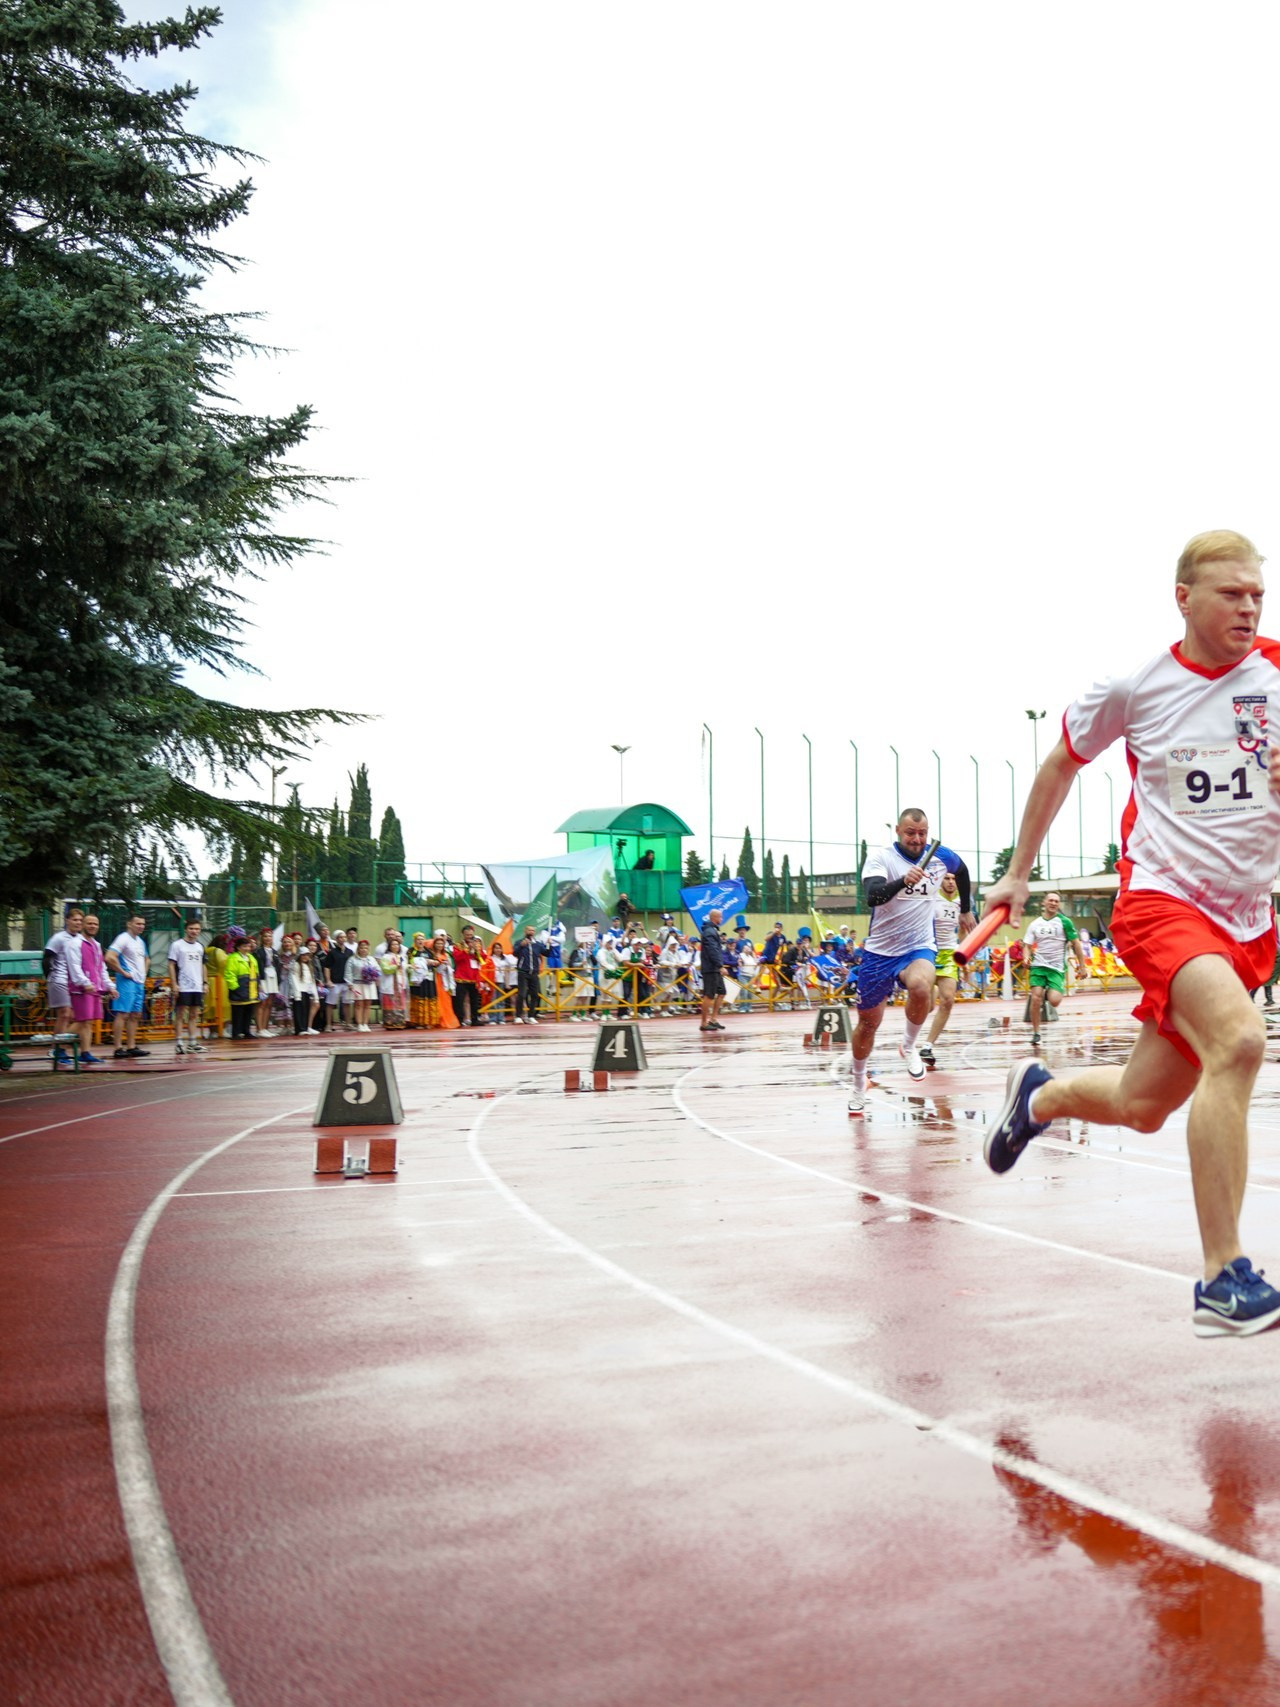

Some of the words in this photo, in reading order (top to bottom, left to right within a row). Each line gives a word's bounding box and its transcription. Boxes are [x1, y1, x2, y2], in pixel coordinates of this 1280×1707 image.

[1186, 767, 1253, 804] 9-1
[1200, 806, 1246, 814] ЛОГИСТИЧЕСКАЯ
[905, 883, 929, 896] 8-1
[944, 909, 956, 919] 7-1
[823, 1012, 840, 1033] 3
[604, 1030, 629, 1058] 4
[342, 1061, 378, 1105] 5
